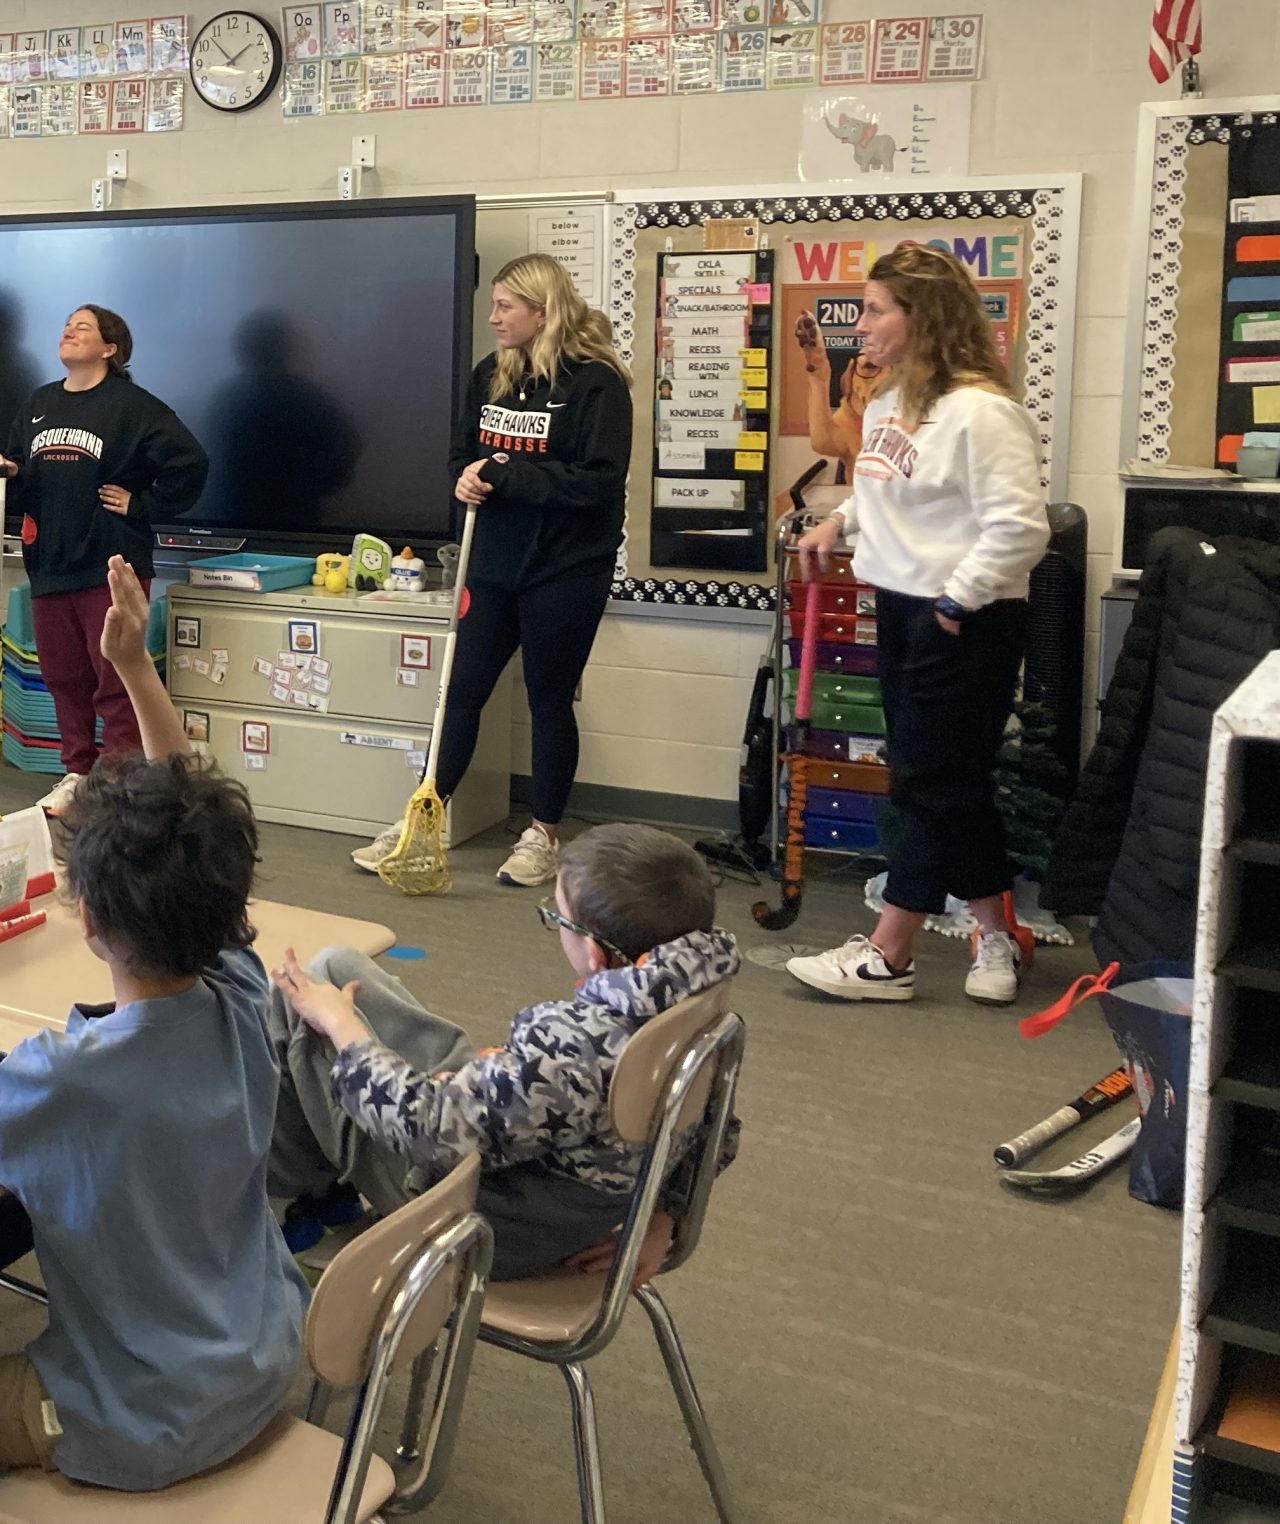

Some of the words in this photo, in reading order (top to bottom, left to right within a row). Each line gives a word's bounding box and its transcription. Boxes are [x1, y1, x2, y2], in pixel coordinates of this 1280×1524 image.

[294, 13, 312, 26] Oo
[334, 8, 350, 24] Pp
[227, 17, 238, 30] 12
[246, 22, 250, 33] 1
[948, 20, 975, 38] 30
[122, 27, 143, 40] Mm
[212, 25, 221, 37] 11
[842, 26, 866, 43] 28
[895, 22, 921, 40] 29
[57, 34, 72, 48] Kk
[257, 34, 264, 46] 2
[741, 34, 765, 50] 26
[791, 30, 814, 47] 27
[199, 40, 209, 52] 10
[262, 52, 270, 64] 3
[513, 51, 527, 66] 21
[552, 46, 573, 62] 22
[597, 44, 619, 61] 23
[196, 59, 203, 71] 9
[427, 55, 440, 69] 19
[464, 53, 485, 69] 20
[303, 64, 316, 81] 16
[345, 61, 358, 77] 17
[201, 76, 208, 88] 8
[257, 70, 264, 82] 4
[95, 84, 106, 98] 13
[129, 83, 141, 98] 14
[245, 86, 252, 98] 5
[229, 92, 236, 104] 6
[552, 222, 579, 230] below
[698, 260, 720, 268] CKLA
[793, 236, 1020, 282] WELME
[678, 286, 720, 295] SPECIALS
[677, 304, 750, 312] SNACK/BATHROOM
[985, 302, 1000, 312] eek
[820, 303, 858, 324] 2ND
[692, 327, 718, 335] MATH
[996, 331, 1005, 342] 5
[825, 336, 854, 347] TODAY
[857, 336, 867, 347] IS
[689, 346, 720, 354] RECESS
[688, 363, 730, 371] READING
[689, 390, 718, 398] LUNCH
[670, 409, 725, 417] KNOWLEDGE
[502, 413, 546, 434] HAWKS
[687, 430, 719, 438] RECESS
[671, 488, 694, 497] PACK
[697, 489, 709, 497] UP
[361, 736, 393, 748] ABSENT
